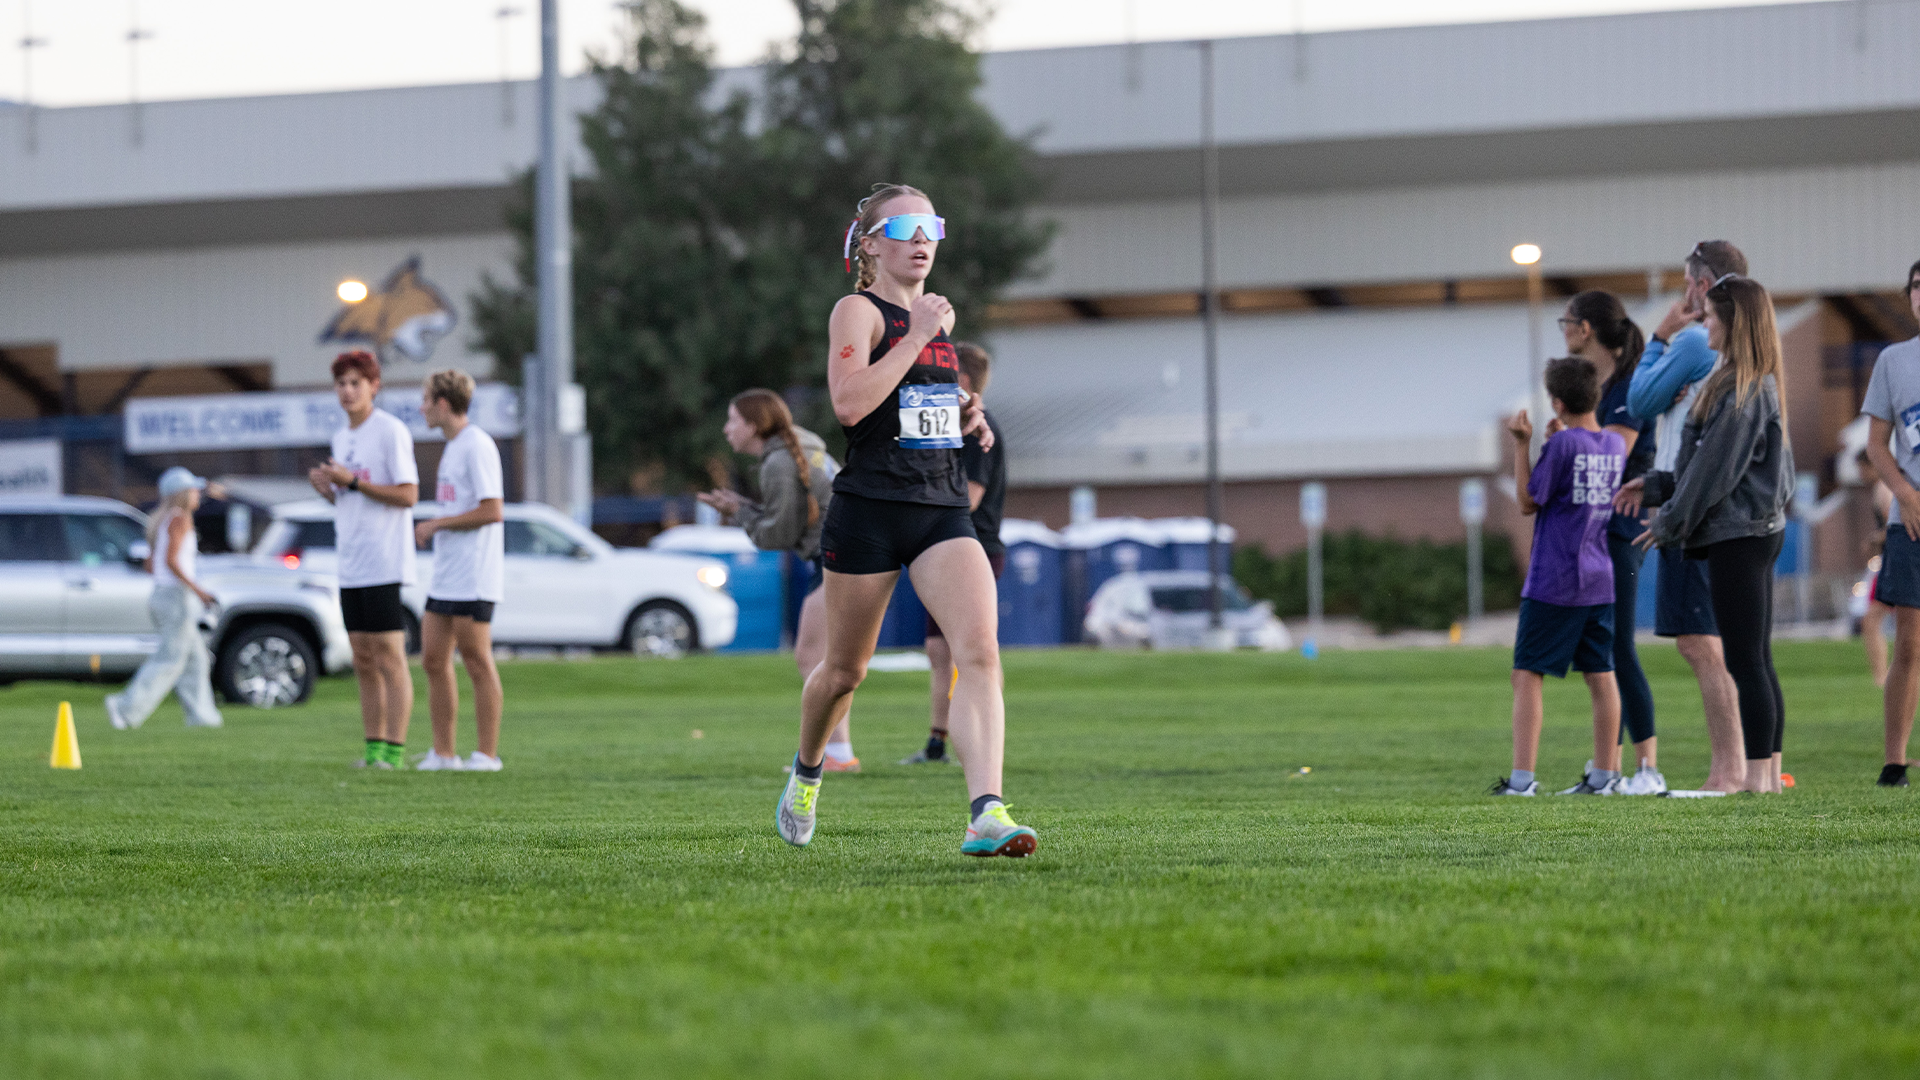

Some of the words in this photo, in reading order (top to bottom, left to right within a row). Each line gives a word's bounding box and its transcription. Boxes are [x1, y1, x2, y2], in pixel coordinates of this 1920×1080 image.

[138, 408, 282, 437] WELCOME
[918, 409, 950, 436] 612
[1573, 454, 1621, 471] SMILE
